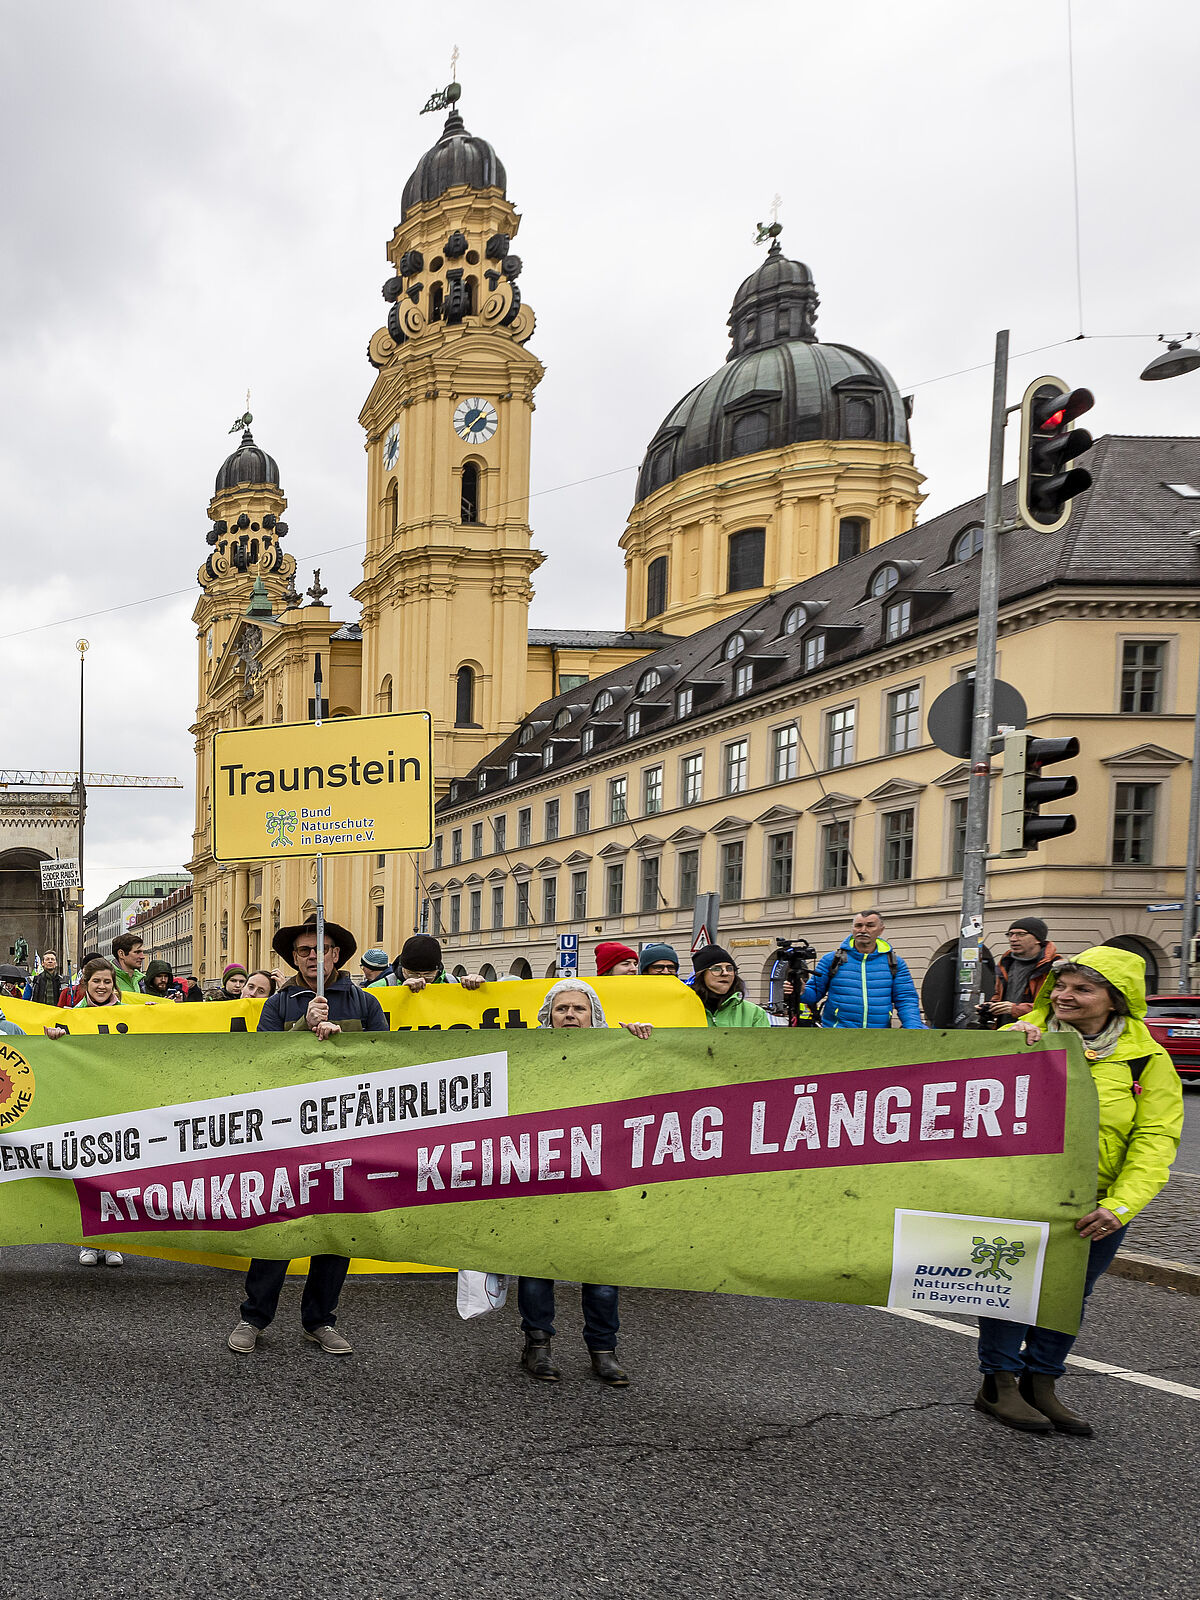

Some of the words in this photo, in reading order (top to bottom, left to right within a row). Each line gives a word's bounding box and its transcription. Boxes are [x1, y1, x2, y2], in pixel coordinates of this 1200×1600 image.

[220, 751, 420, 796] Traunstein
[301, 806, 331, 818] Bund
[301, 818, 374, 832] Naturschutz
[301, 835, 311, 845] in
[315, 833, 352, 845] Bayern
[356, 831, 374, 841] e.V.
[564, 936, 574, 948] U
[174, 1108, 264, 1154] TEUER
[299, 1071, 492, 1135] GEFÄHRLICH
[100, 1158, 353, 1223] ATOMKRAFT
[416, 1122, 602, 1193] KEINEN
[624, 1106, 724, 1169] TAG
[750, 1074, 1031, 1155] LÄNGER!
[915, 1265, 972, 1277] BUND
[914, 1278, 1012, 1295] Naturschutz
[912, 1290, 925, 1299] in
[930, 1291, 982, 1304] Bayern
[986, 1297, 1010, 1309] e.V.
